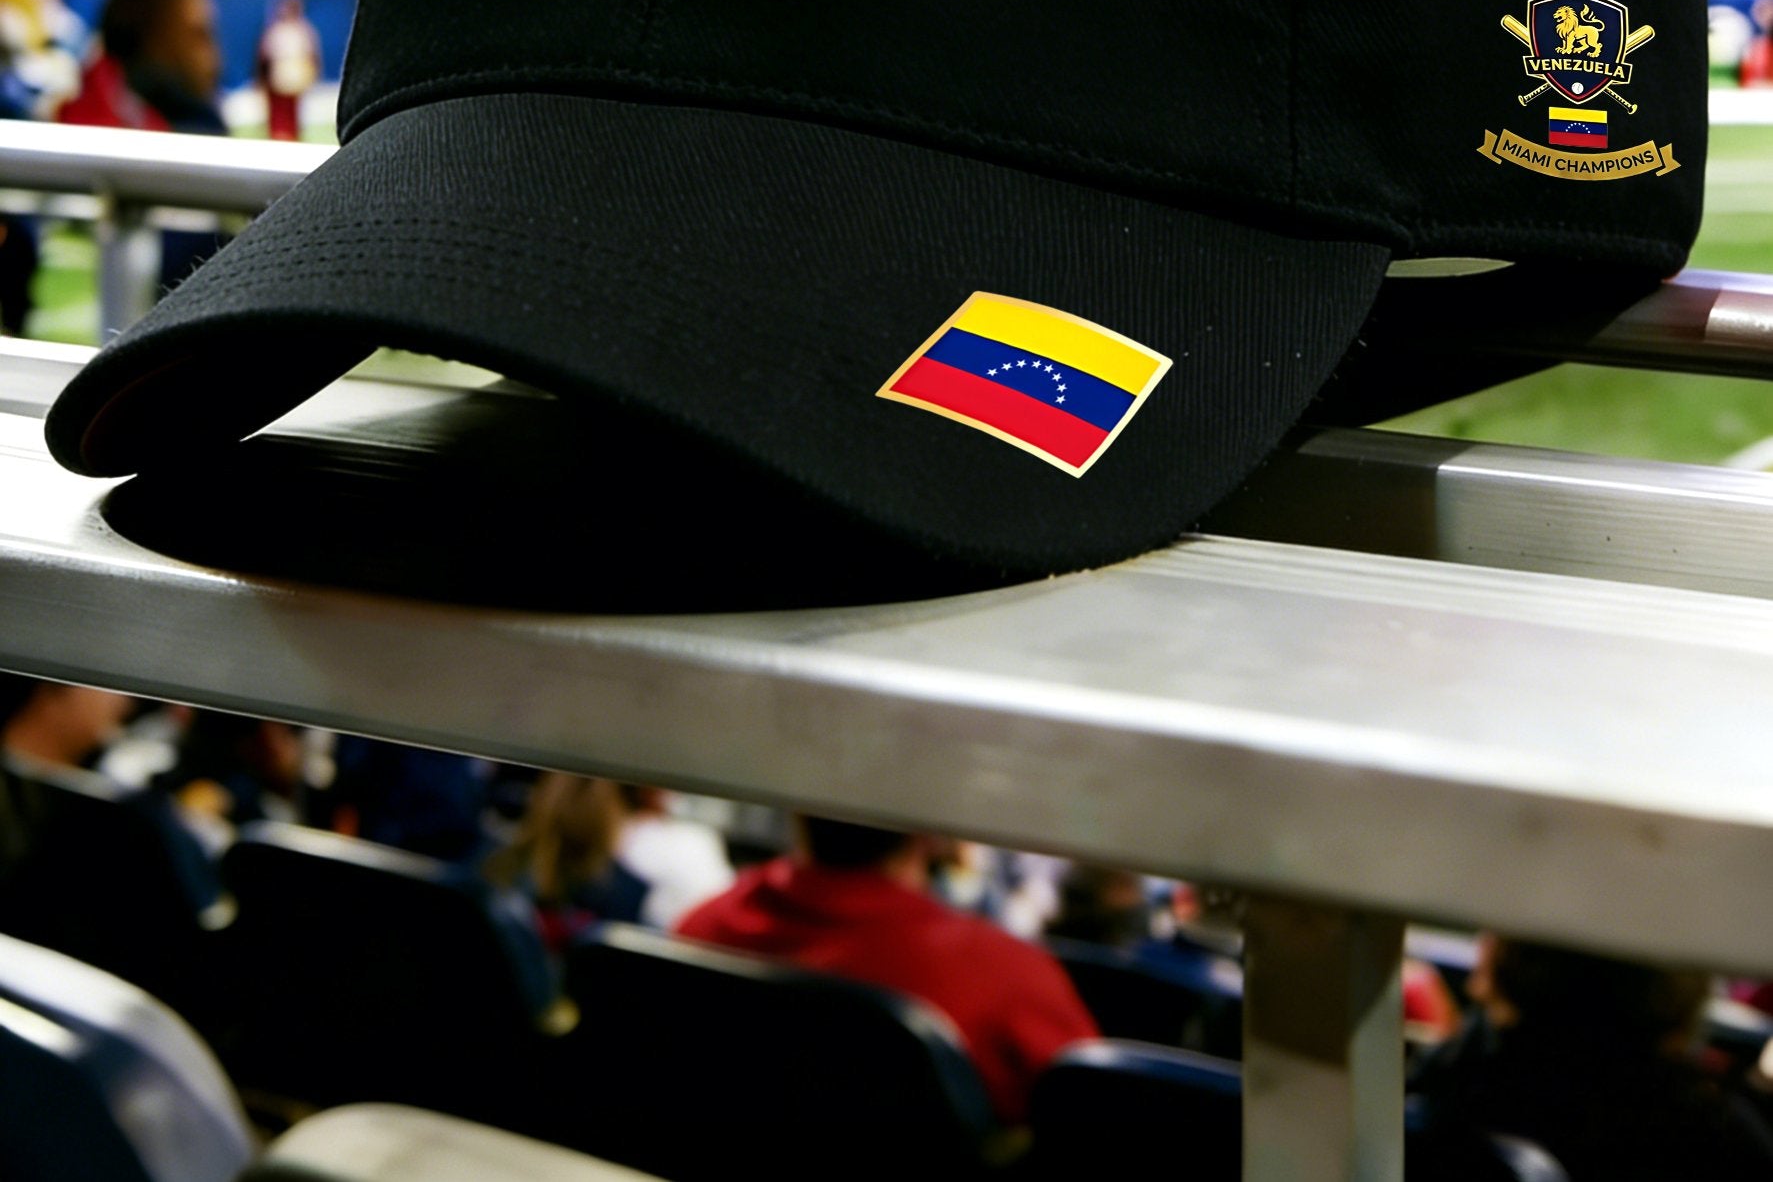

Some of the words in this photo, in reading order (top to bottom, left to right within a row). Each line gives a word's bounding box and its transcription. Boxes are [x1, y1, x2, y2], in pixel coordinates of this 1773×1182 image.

[1529, 58, 1625, 78] VENEZUELA
[1502, 139, 1550, 168] MIAMI
[1555, 150, 1655, 173] CHAMPIONS
